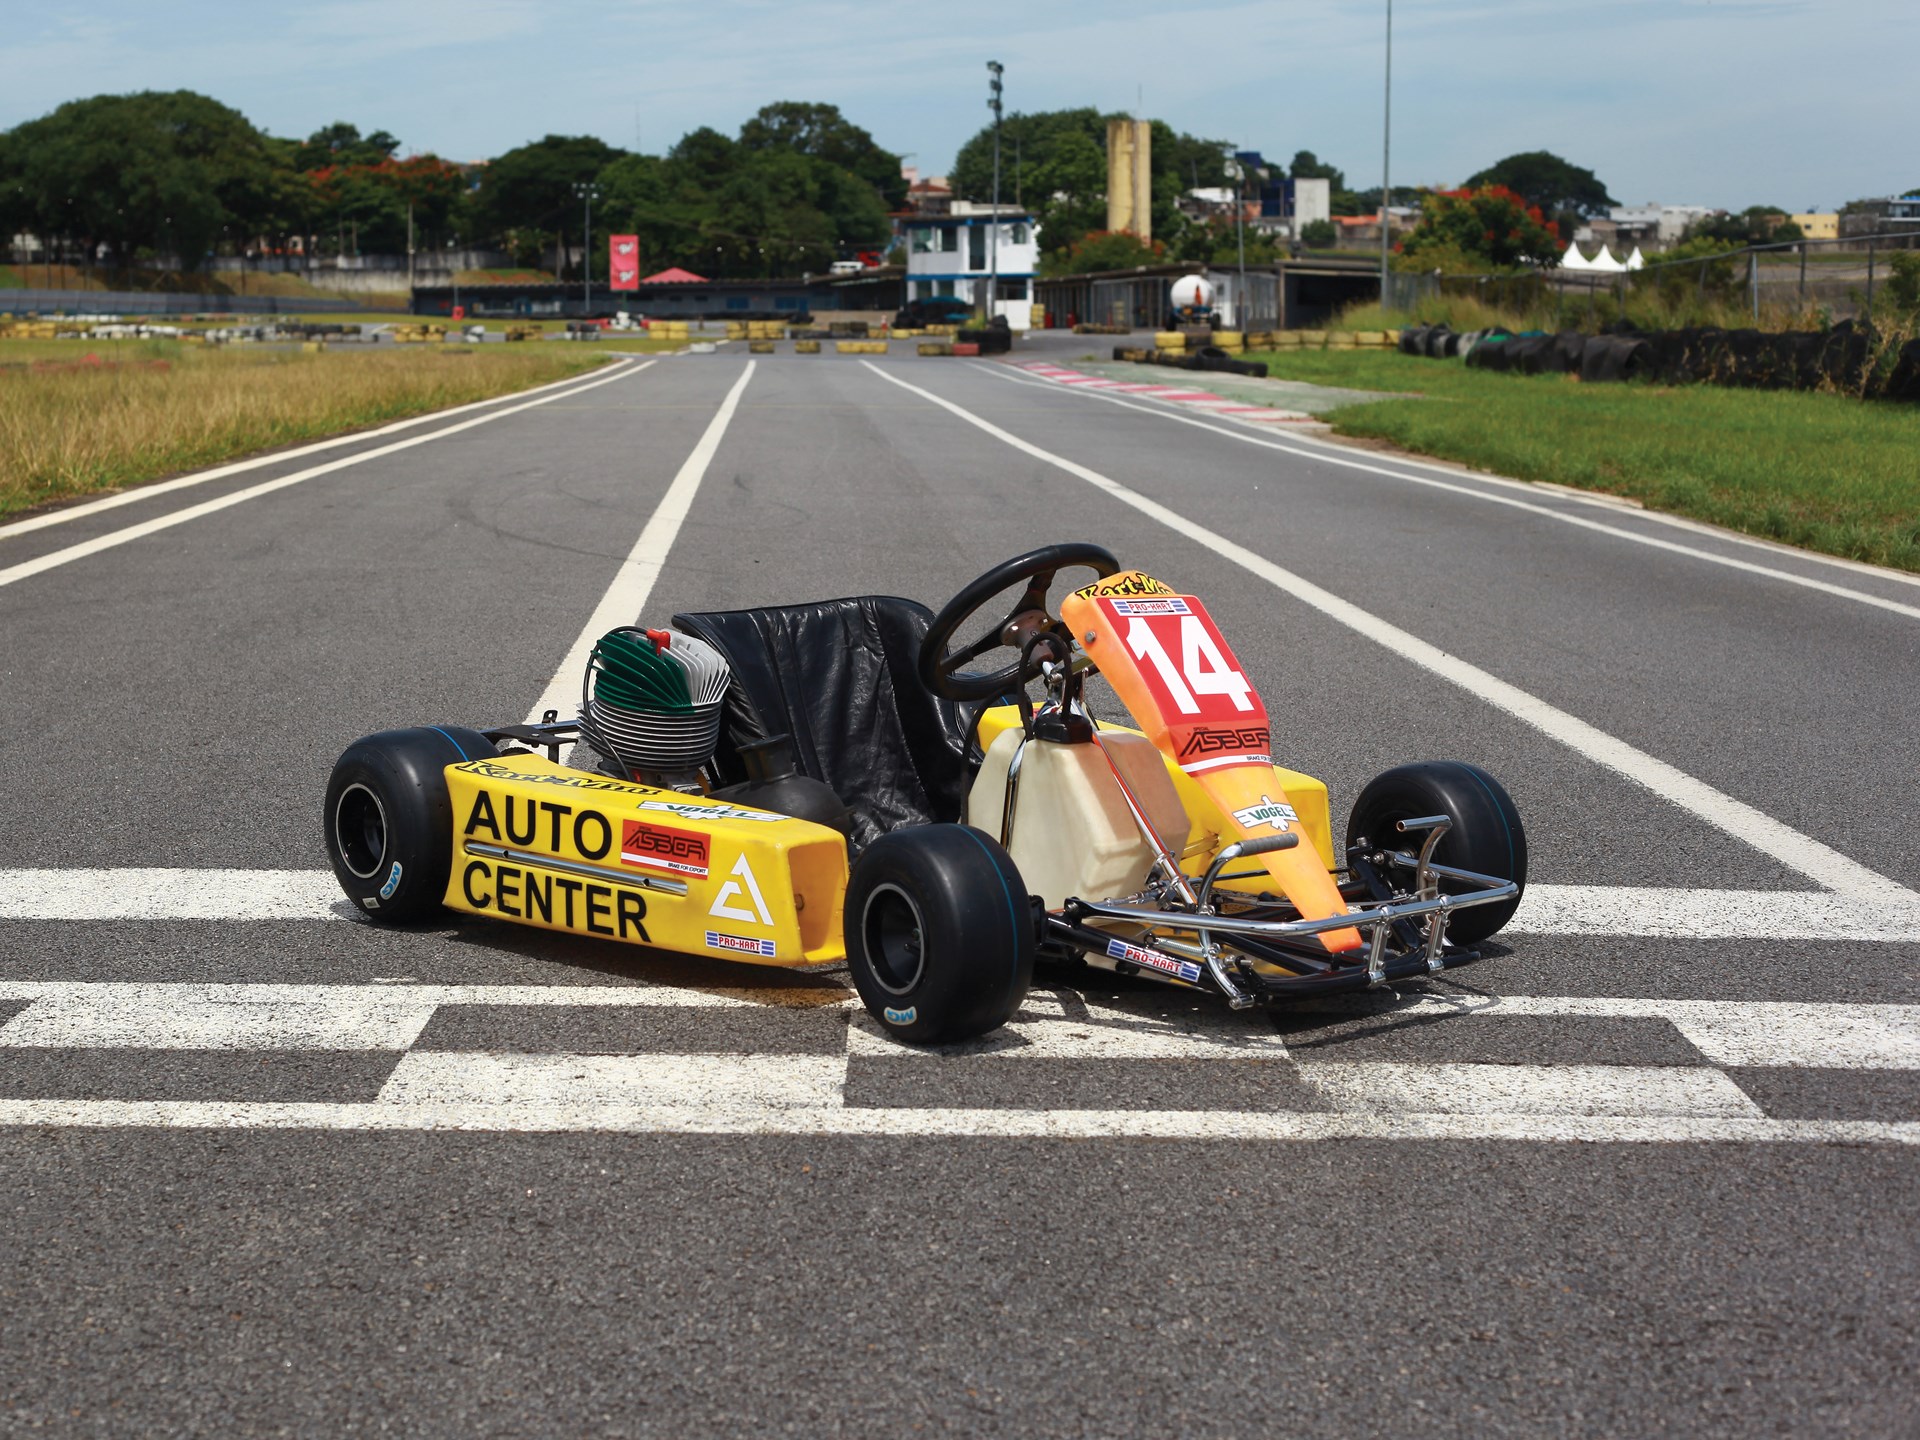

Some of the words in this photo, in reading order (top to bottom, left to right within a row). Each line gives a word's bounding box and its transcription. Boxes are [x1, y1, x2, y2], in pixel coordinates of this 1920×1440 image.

[1128, 602, 1173, 611] PRO-KART
[1126, 616, 1255, 714] 14
[666, 804, 757, 819] VOGEL
[1247, 806, 1292, 821] VOGEL
[464, 789, 612, 861] AUTO
[688, 866, 707, 874] EXPORT
[381, 864, 401, 896] MG
[462, 860, 652, 943] CENTER
[718, 936, 760, 951] PRO-KART
[1125, 948, 1181, 973] PRO-KART
[886, 1008, 914, 1022] MG
